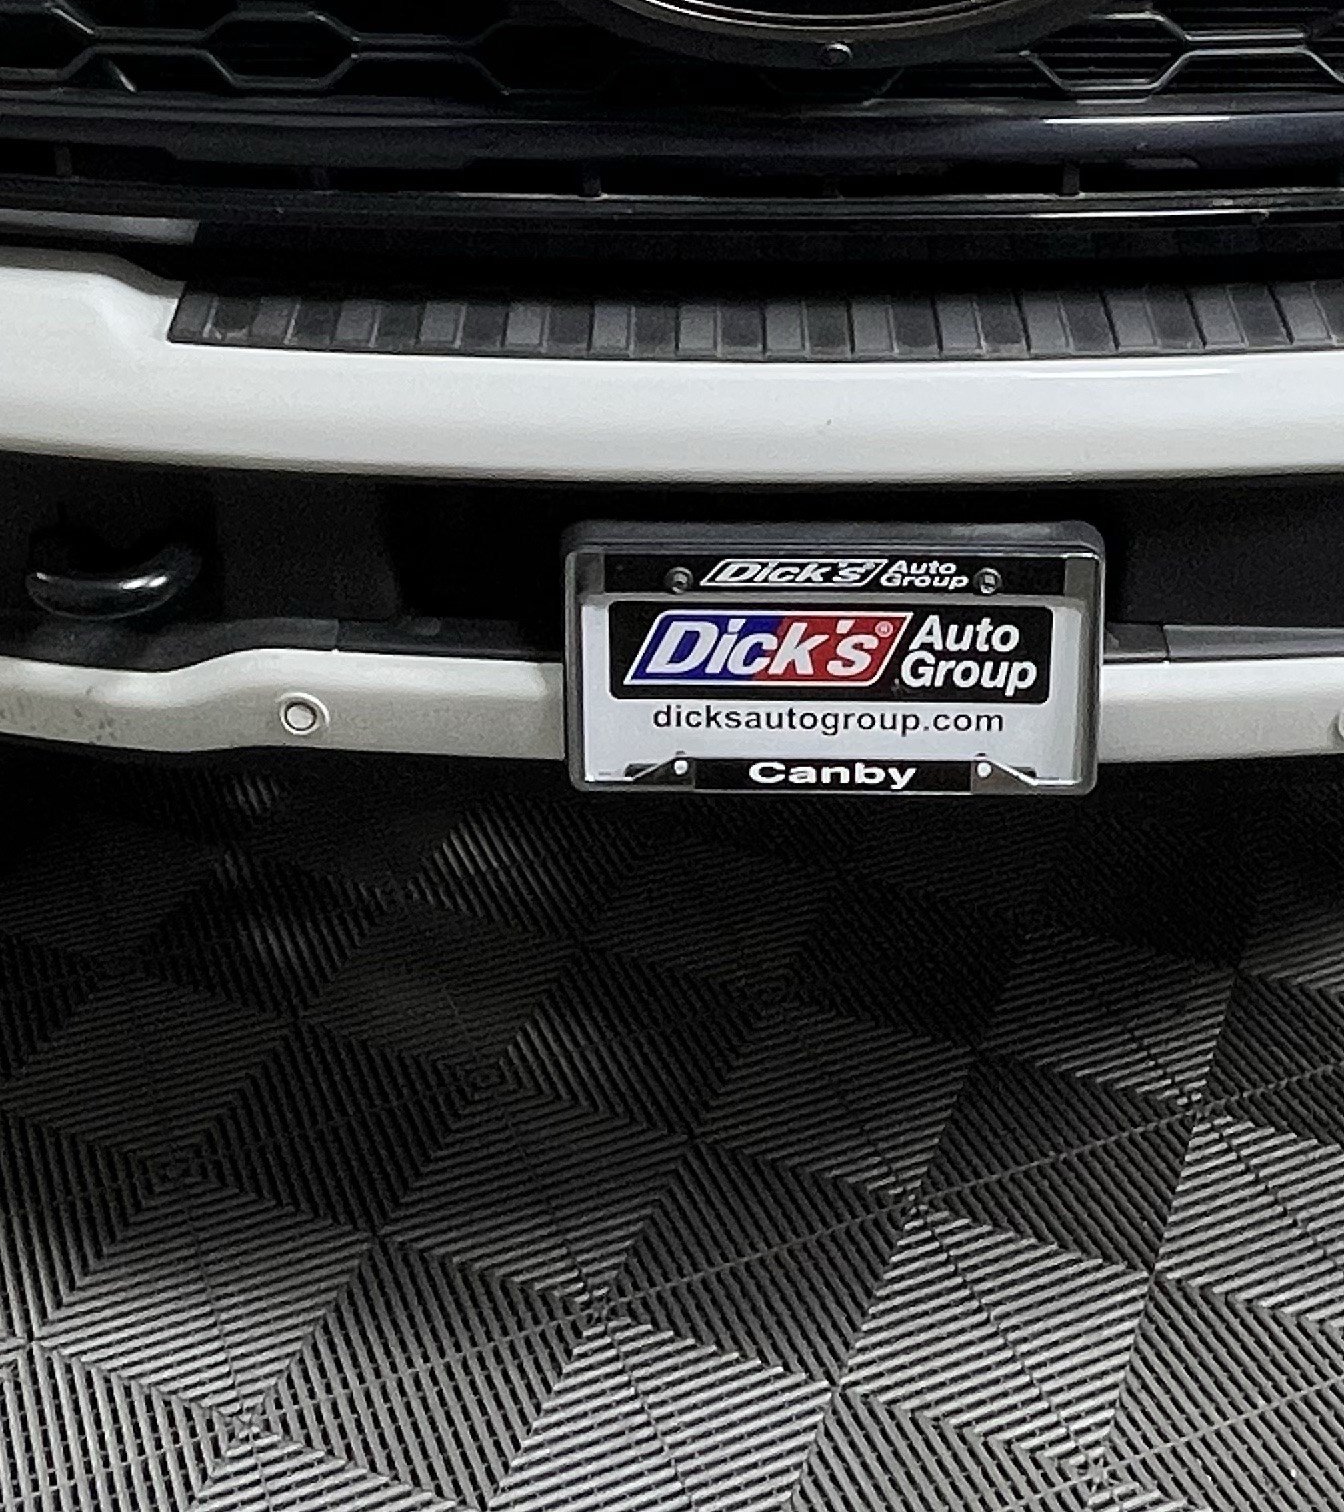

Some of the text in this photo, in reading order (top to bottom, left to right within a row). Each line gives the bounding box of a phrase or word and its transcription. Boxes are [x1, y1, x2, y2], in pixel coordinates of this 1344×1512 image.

[880, 573, 969, 590] Group
[887, 560, 957, 575] Auto
[908, 614, 1020, 652] Auto
[901, 650, 1038, 698] Group
[653, 705, 1005, 737] dicksautogroup.com
[748, 762, 918, 790] Canby
